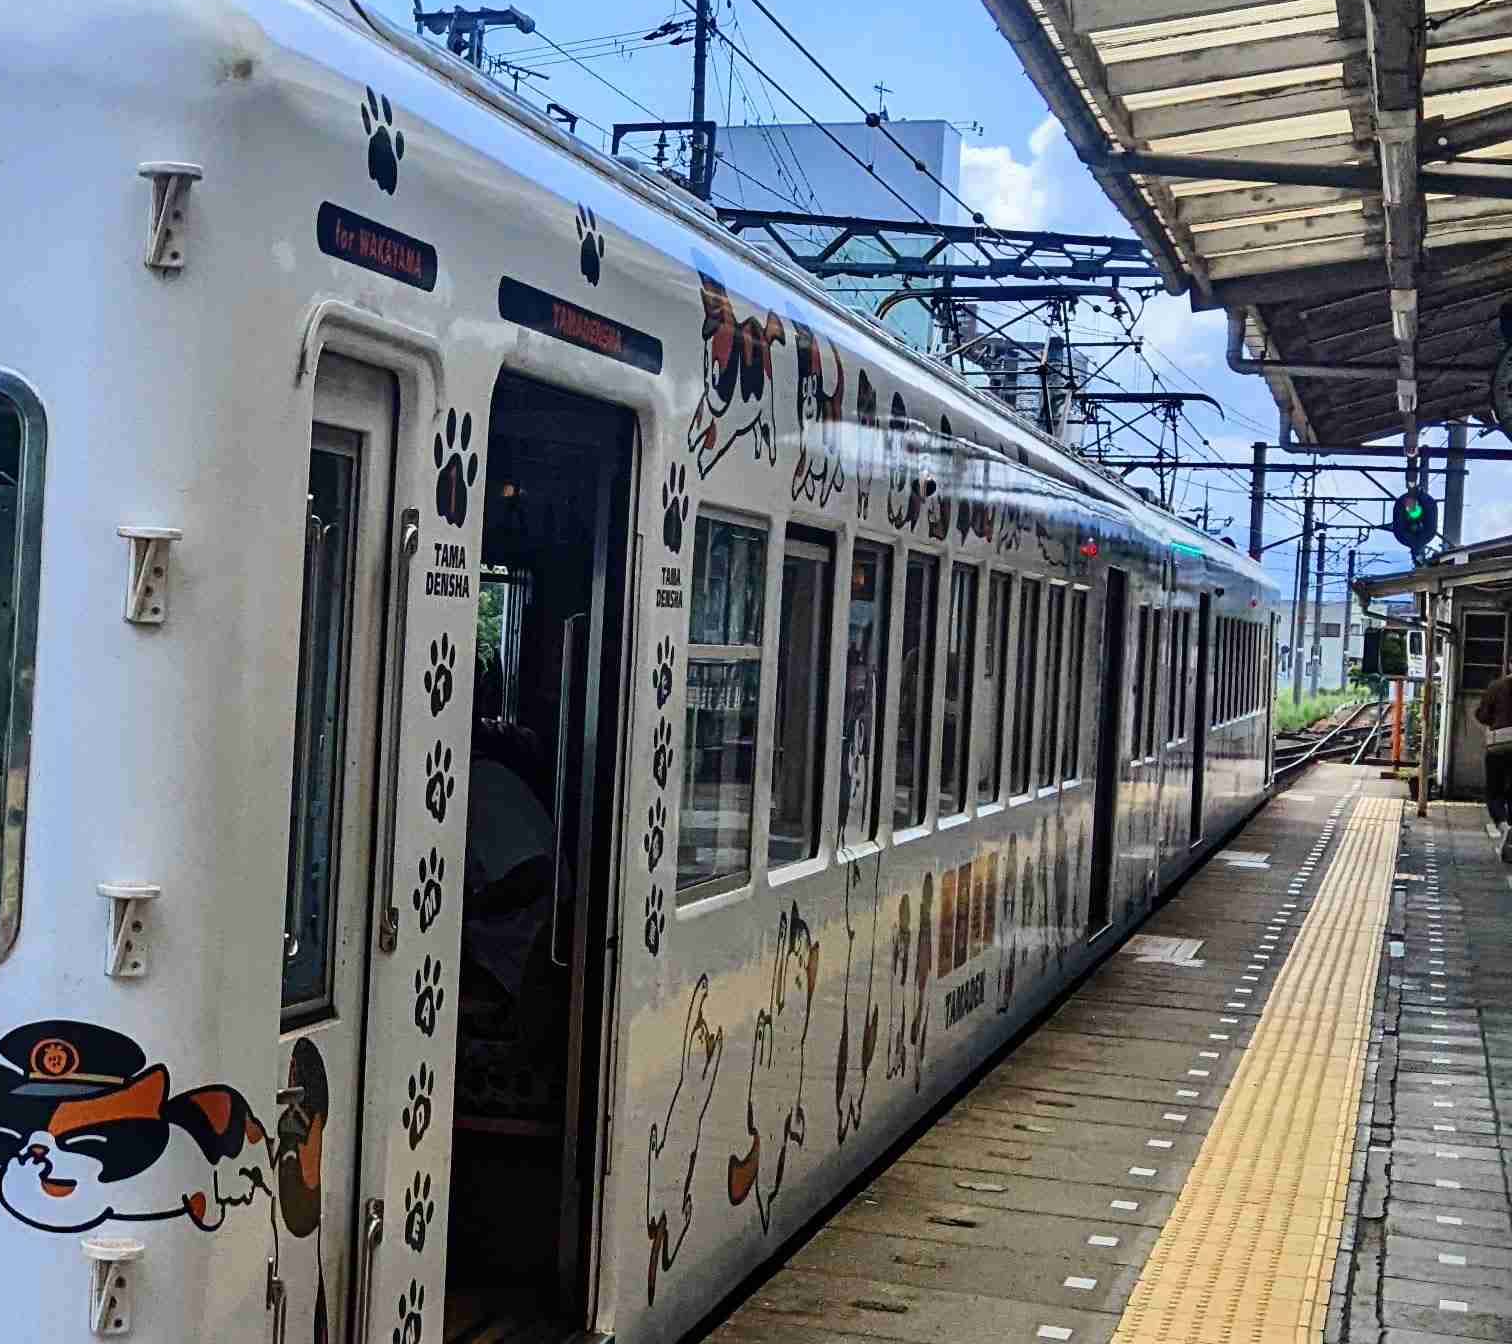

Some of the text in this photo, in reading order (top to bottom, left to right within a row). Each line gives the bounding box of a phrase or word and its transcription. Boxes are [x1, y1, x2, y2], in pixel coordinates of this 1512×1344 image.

[434, 543, 466, 570] TAMA
[425, 571, 470, 598] DENSHA
[661, 567, 681, 586] TAMA
[656, 589, 683, 608] DENSHA
